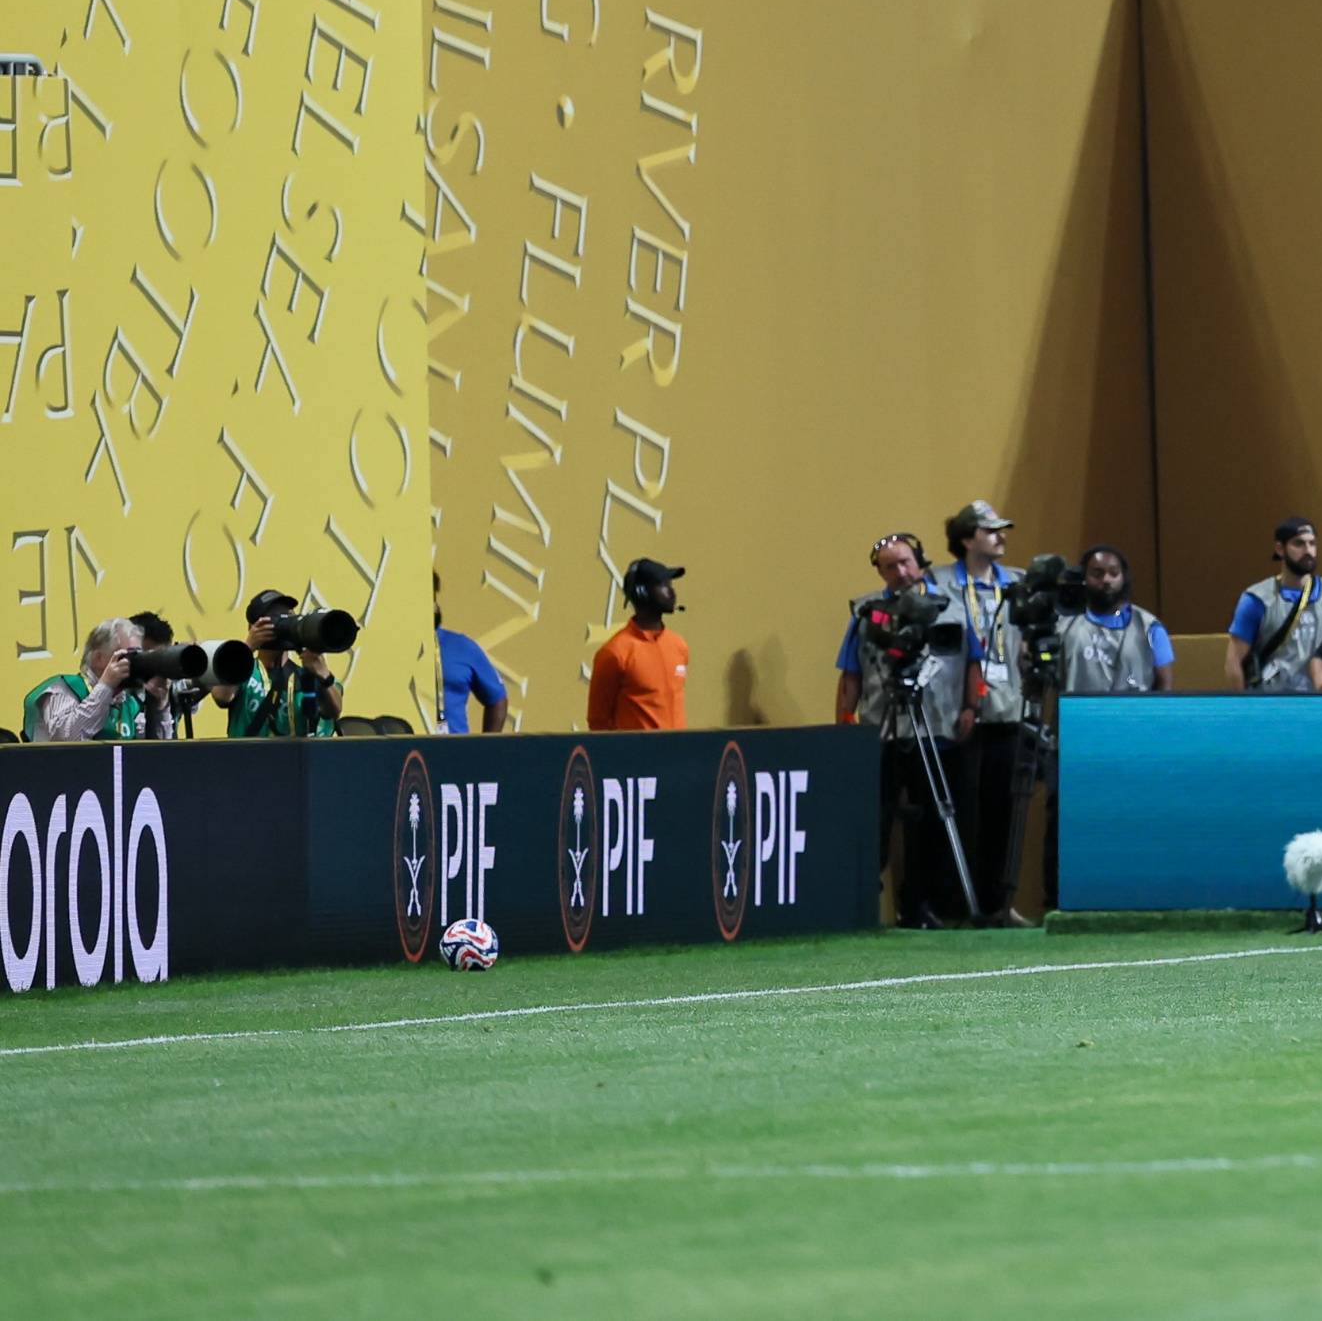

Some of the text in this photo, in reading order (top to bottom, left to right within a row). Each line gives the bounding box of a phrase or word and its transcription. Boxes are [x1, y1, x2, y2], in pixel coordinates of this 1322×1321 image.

[619, 5, 704, 387] RIVER
[481, 170, 590, 734] FLUMIN
[0, 745, 169, 993] orola
[441, 782, 499, 928] PIF
[603, 776, 658, 918] PIF
[754, 769, 809, 907] PIF
